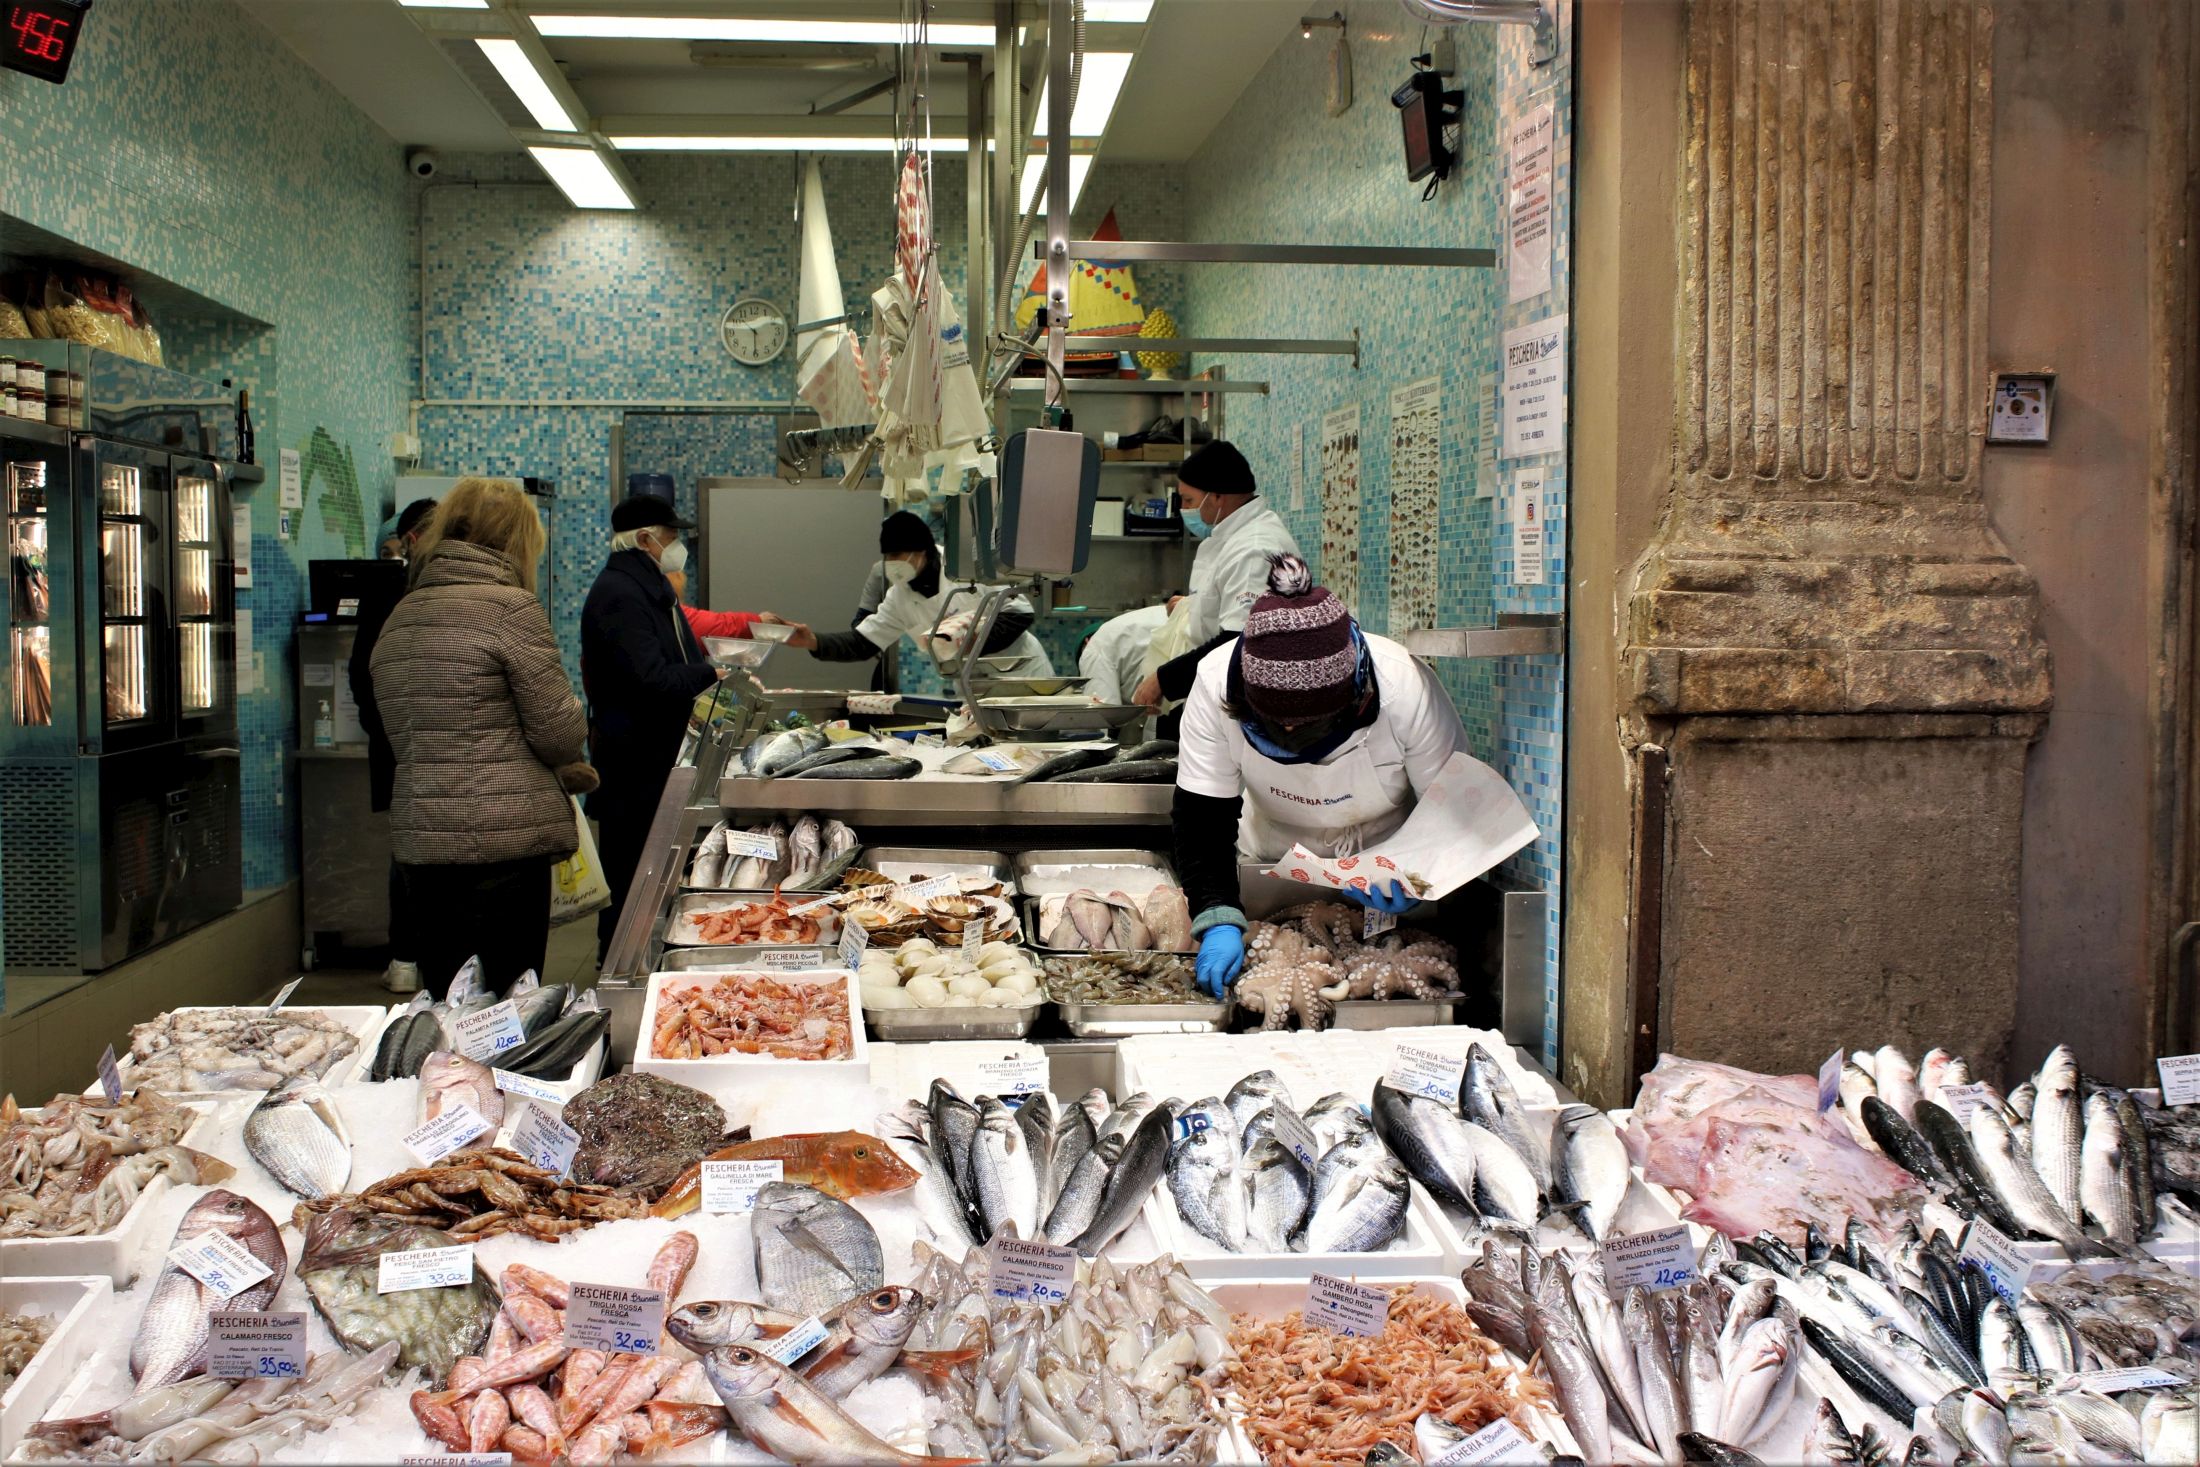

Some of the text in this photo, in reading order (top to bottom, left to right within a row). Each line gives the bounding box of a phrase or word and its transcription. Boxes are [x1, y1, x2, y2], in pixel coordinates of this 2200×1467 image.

[11, 7, 69, 61] 456
[740, 310, 746, 318] 11
[750, 306, 759, 315] 12
[729, 329, 735, 337] 9
[775, 327, 780, 336] 3
[742, 346, 747, 355] 7
[753, 349, 759, 357] 6
[764, 346, 770, 354] 5
[1509, 342, 1540, 367] PESCHERIA
[1270, 786, 1321, 805] PESCHERIA
[903, 880, 935, 892] PESCHERIA
[764, 953, 799, 961] PESCHERIA
[456, 1011, 492, 1031] PESCHERIA
[466, 1024, 490, 1036] PALAMITA
[1397, 1044, 1438, 1061] PESCHERIA
[1400, 1054, 1418, 1063] TONNO
[979, 1061, 1020, 1069] PESCHERIA
[1416, 1063, 1438, 1073] FRESCO
[528, 1102, 560, 1131] PESCHERIA
[403, 1116, 445, 1144] PESCHERIA
[705, 1164, 751, 1172] PESCHERIA
[1606, 1234, 1657, 1253] PESCHERIA
[1975, 1220, 2009, 1253] PESCHERIA
[208, 1232, 247, 1260] PESCHERIA
[998, 1240, 1045, 1257] PESCHERIA
[1616, 1244, 1680, 1262] MERLUZZO FRESCO
[385, 1251, 437, 1262] PESCHERIA
[1002, 1256, 1064, 1271] CALAMARO FRESCO
[1999, 1254, 2019, 1272] FRESCO
[1312, 1274, 1358, 1296] PESCHERIA
[1655, 1268, 1687, 1286] 12,00
[574, 1286, 628, 1302] PESCHERIA
[1033, 1282, 1062, 1300] 20,00
[589, 1300, 643, 1313] TRIGLIA ROSSA
[1322, 1289, 1373, 1310] GAMBERO ROSA
[600, 1308, 629, 1318] FRESCA
[213, 1317, 268, 1328] PESCHERIA
[615, 1331, 647, 1353] 32,00
[259, 1357, 292, 1377] 35,00
[1496, 1438, 1521, 1457] FRESCA
[404, 1458, 466, 1467] PESCHERIA
